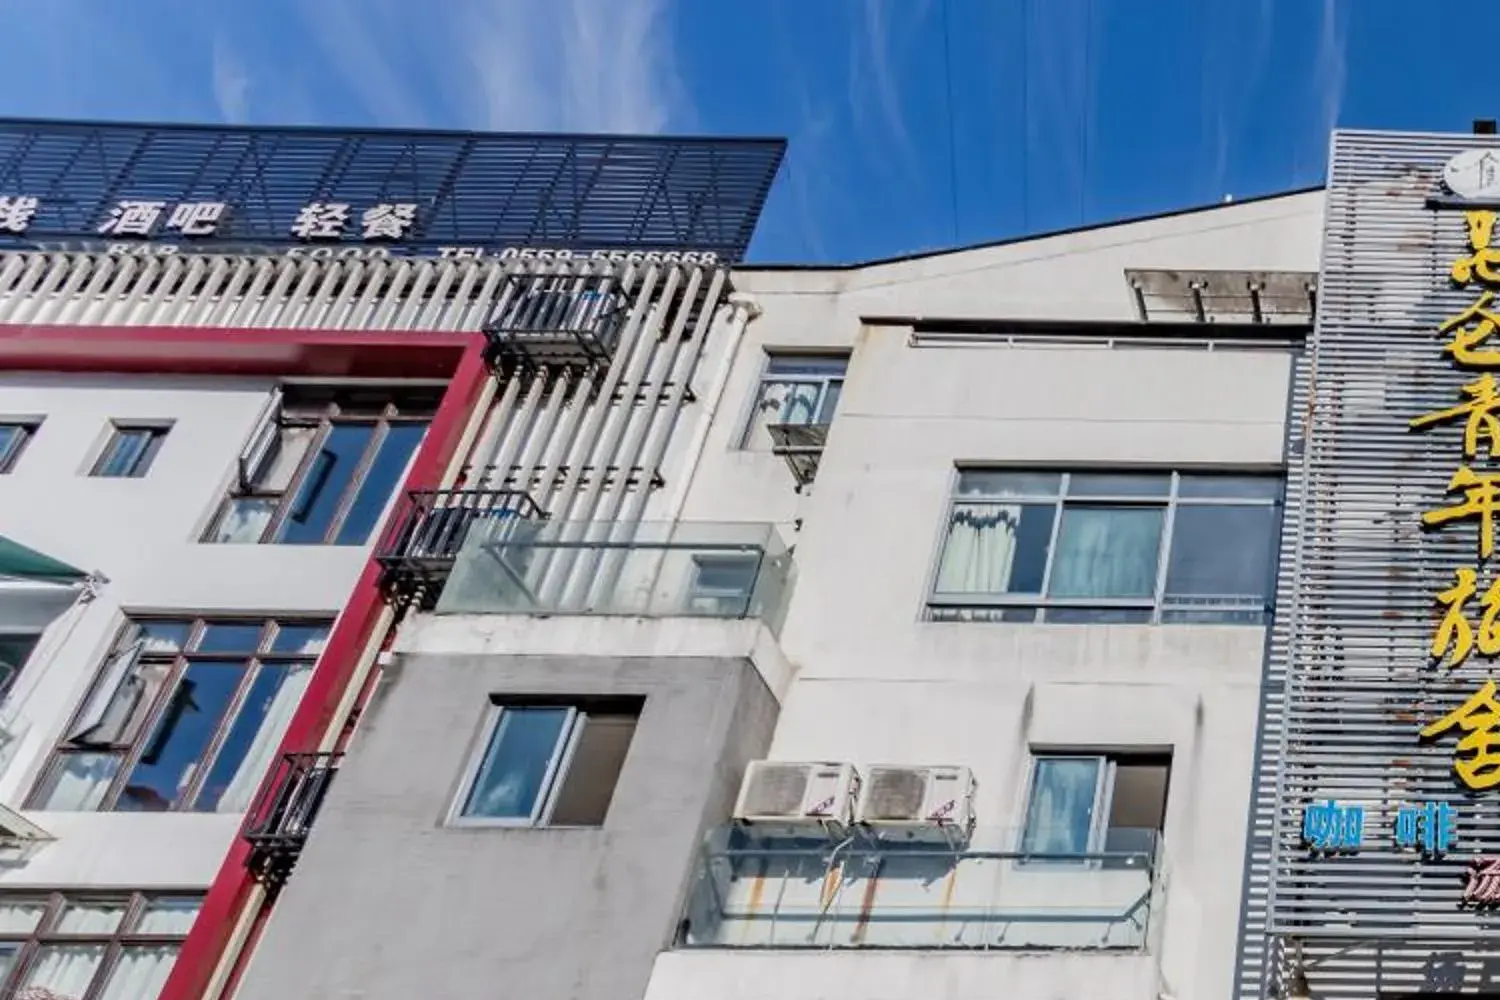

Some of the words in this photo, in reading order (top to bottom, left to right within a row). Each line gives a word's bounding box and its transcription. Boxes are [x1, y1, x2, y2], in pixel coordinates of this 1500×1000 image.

[96, 200, 224, 236] 酒吧
[291, 203, 417, 239] 轻餐
[1304, 801, 1458, 857] 咖啡
